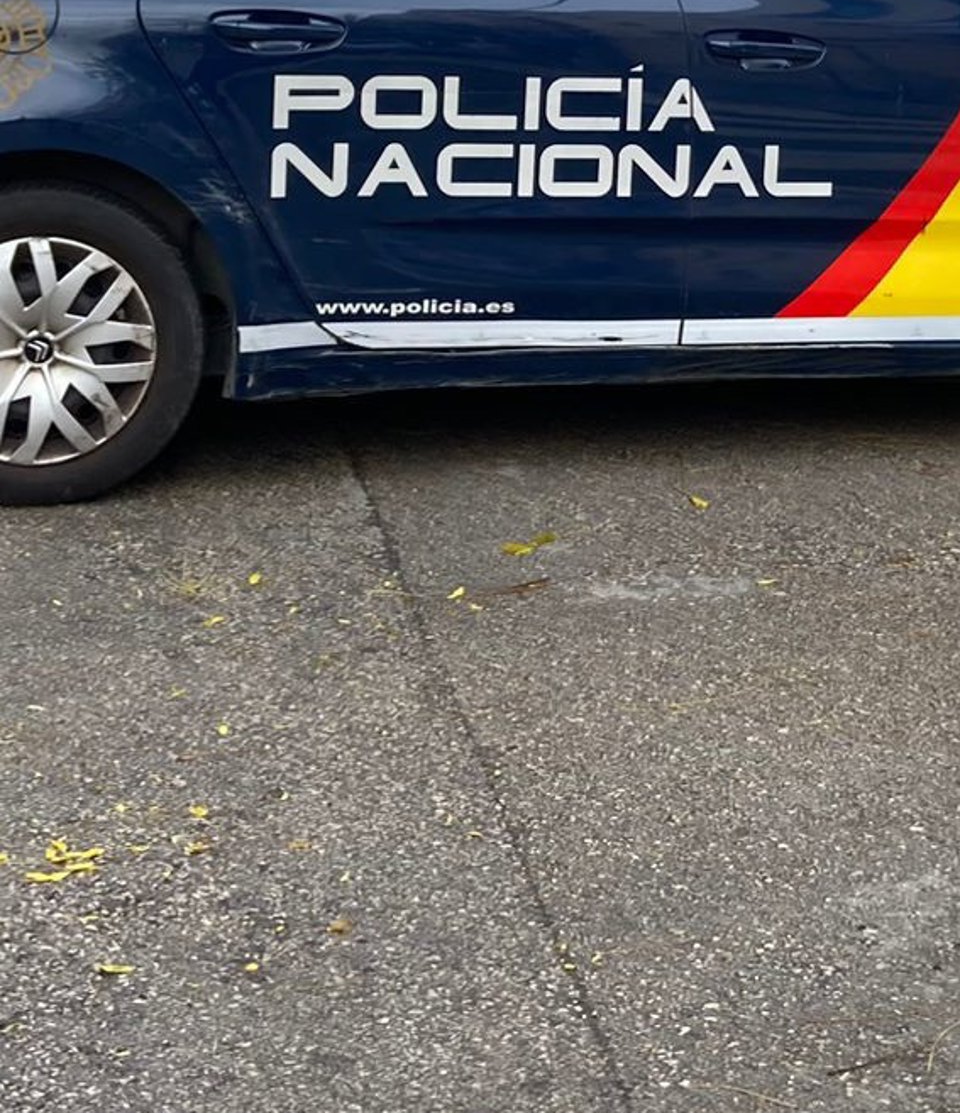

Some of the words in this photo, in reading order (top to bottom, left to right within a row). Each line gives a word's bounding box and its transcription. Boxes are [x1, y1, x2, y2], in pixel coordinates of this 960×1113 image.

[272, 64, 716, 133] POLICÍA
[269, 142, 834, 200] NACIONAL
[315, 298, 516, 318] www.policia.es
